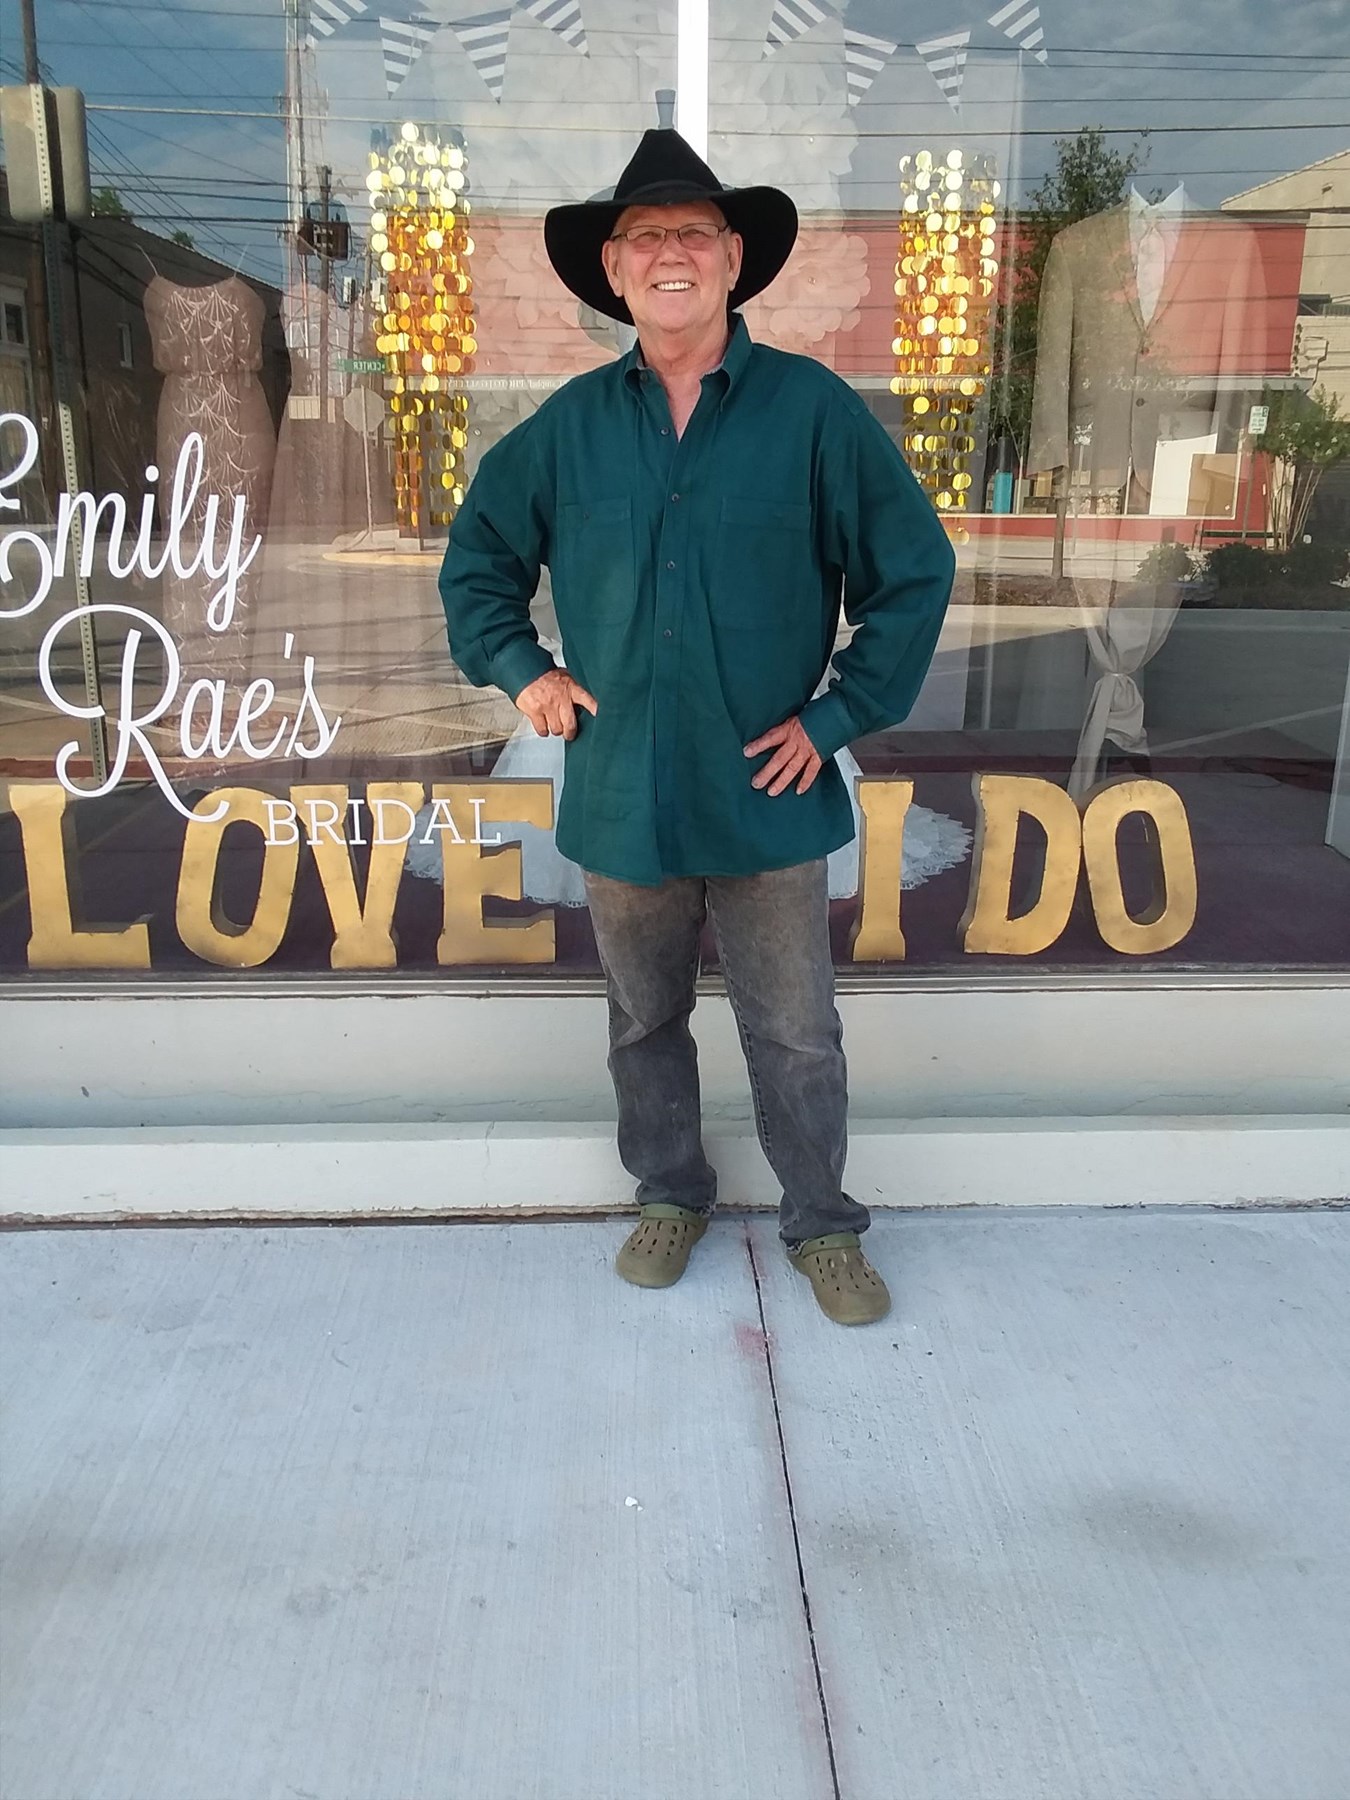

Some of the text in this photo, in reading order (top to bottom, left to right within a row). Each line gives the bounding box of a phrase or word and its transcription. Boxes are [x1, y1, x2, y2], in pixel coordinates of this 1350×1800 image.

[0, 412, 262, 632] Emily
[39, 604, 342, 822] Rae's
[8, 771, 1197, 969] LOVE I DO
[262, 798, 501, 846] BRIDAL
